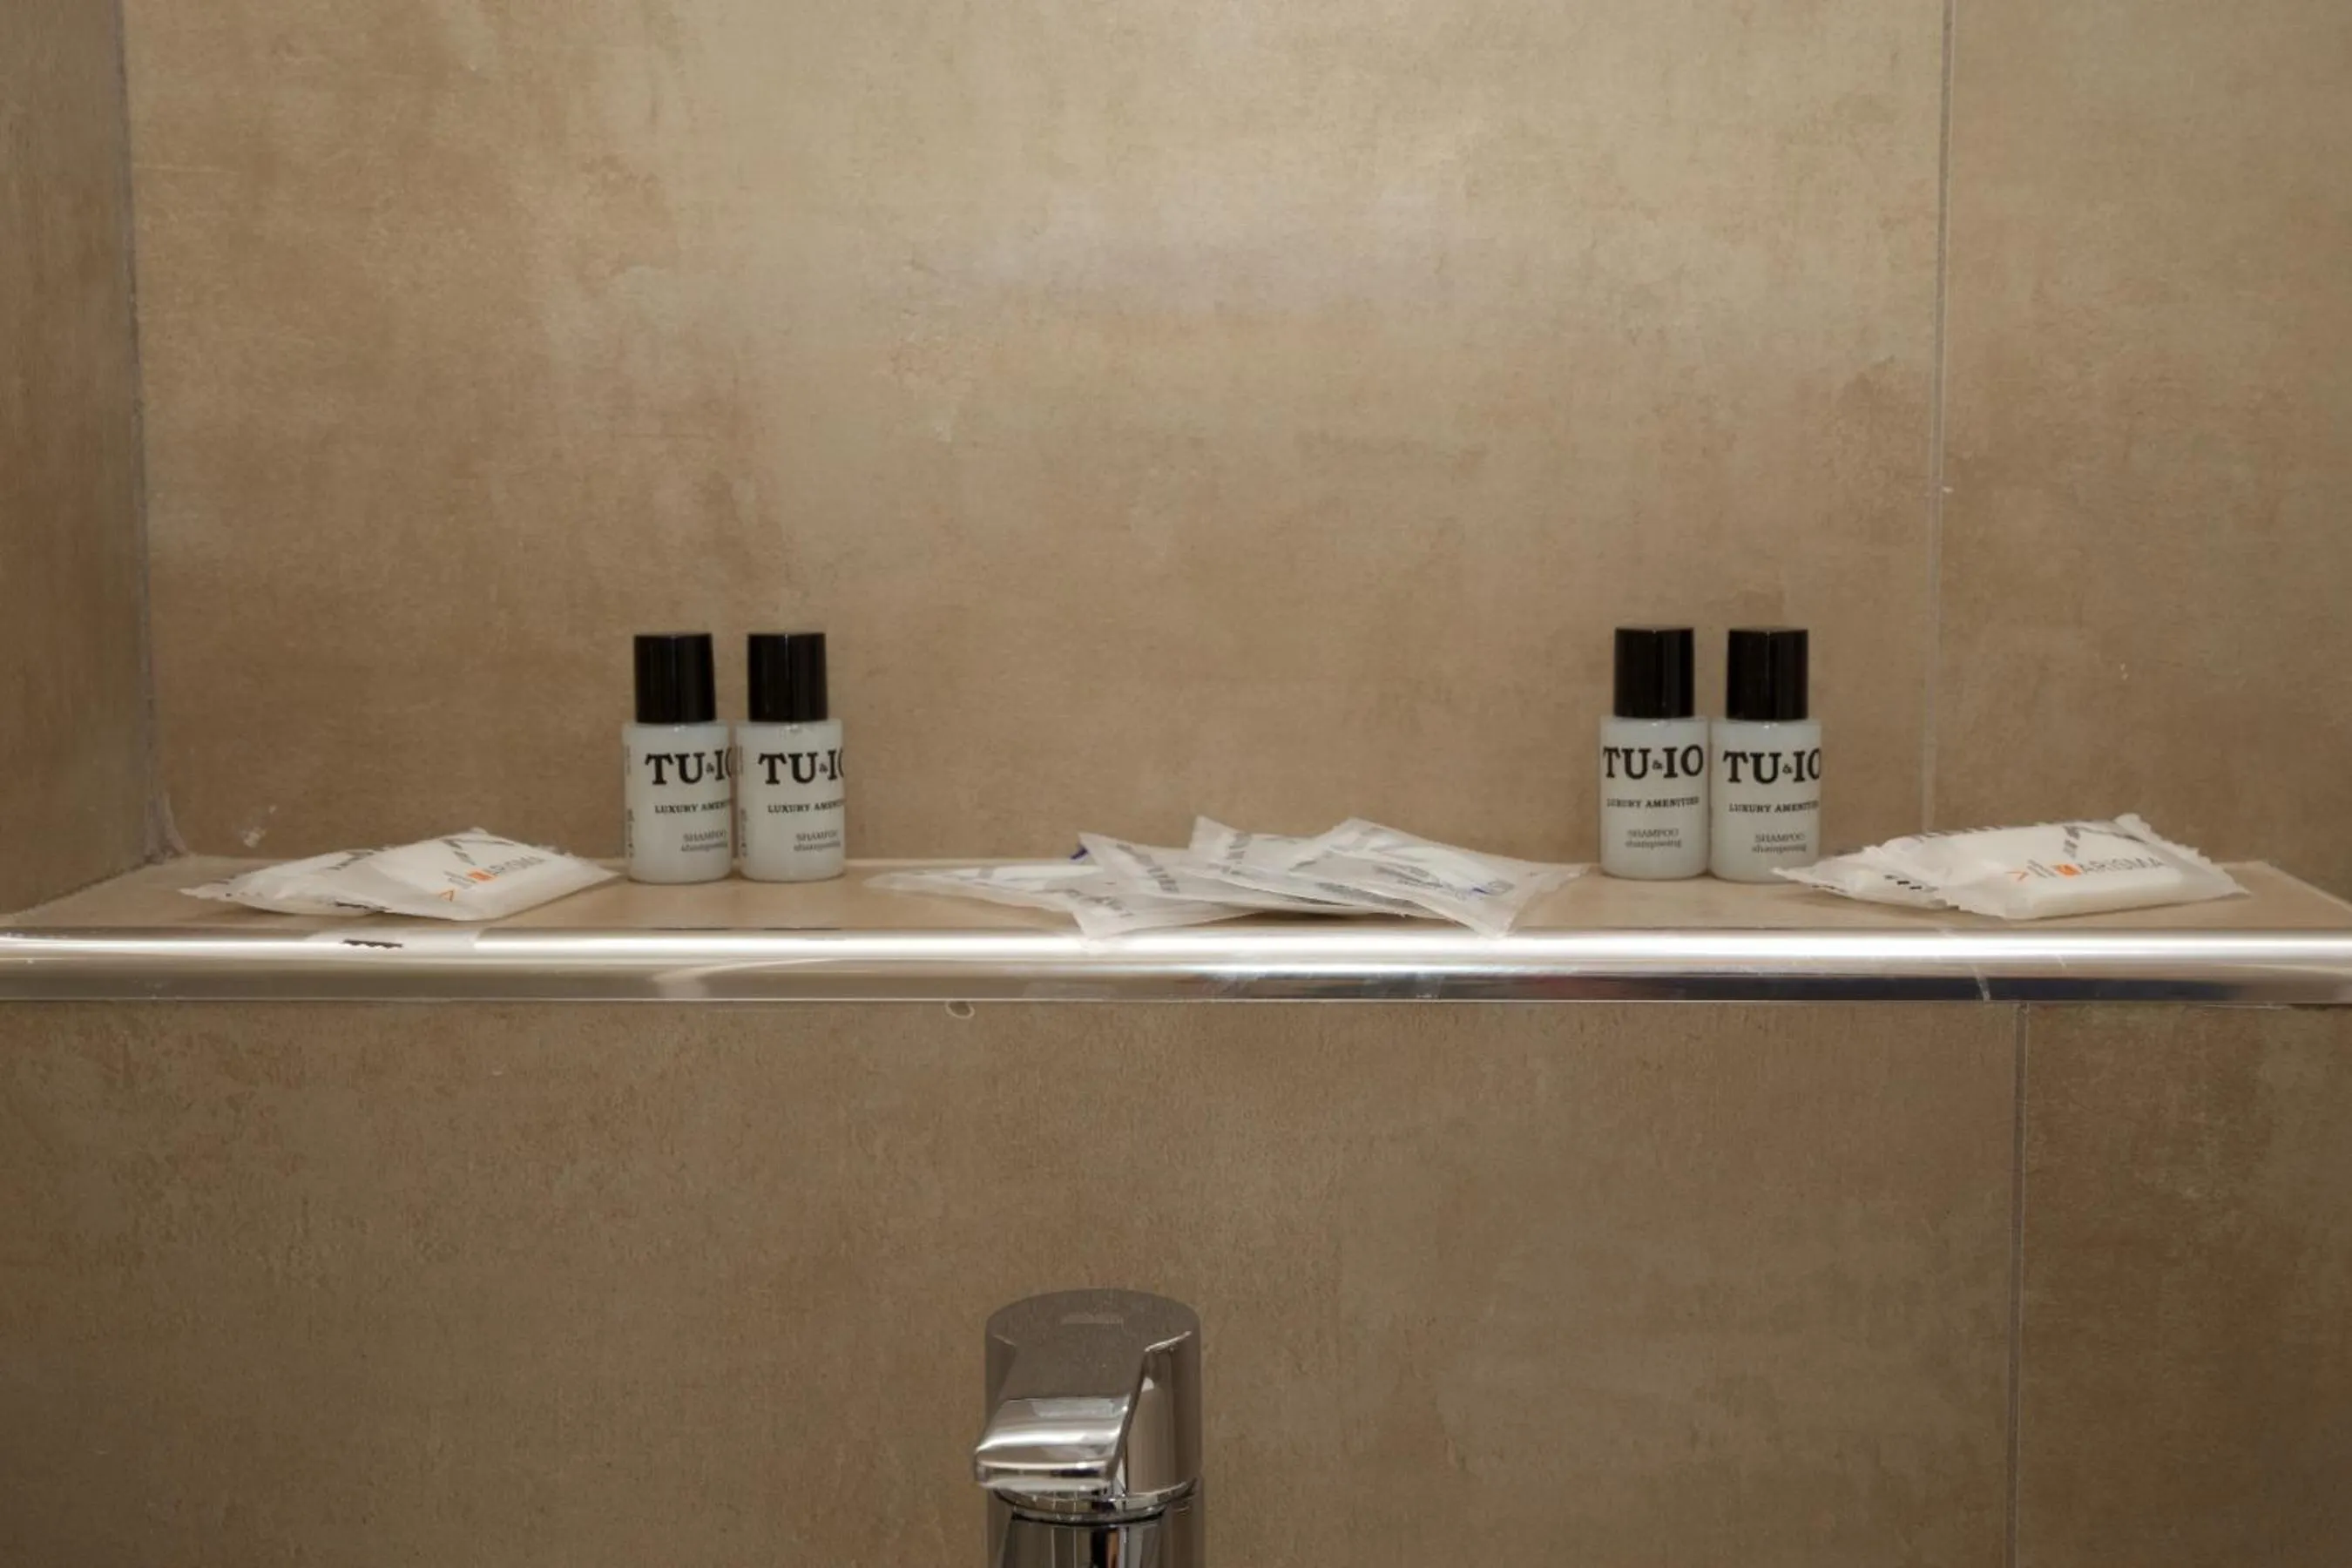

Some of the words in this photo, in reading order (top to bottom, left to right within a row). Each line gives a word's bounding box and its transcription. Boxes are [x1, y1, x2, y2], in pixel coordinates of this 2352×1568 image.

[1602, 744, 1704, 780] TU&IO
[1645, 796, 1700, 808] AMENITIES
[1729, 802, 1772, 813] LUXURY
[654, 804, 698, 814] LUXURY
[767, 804, 810, 814] LUXURY
